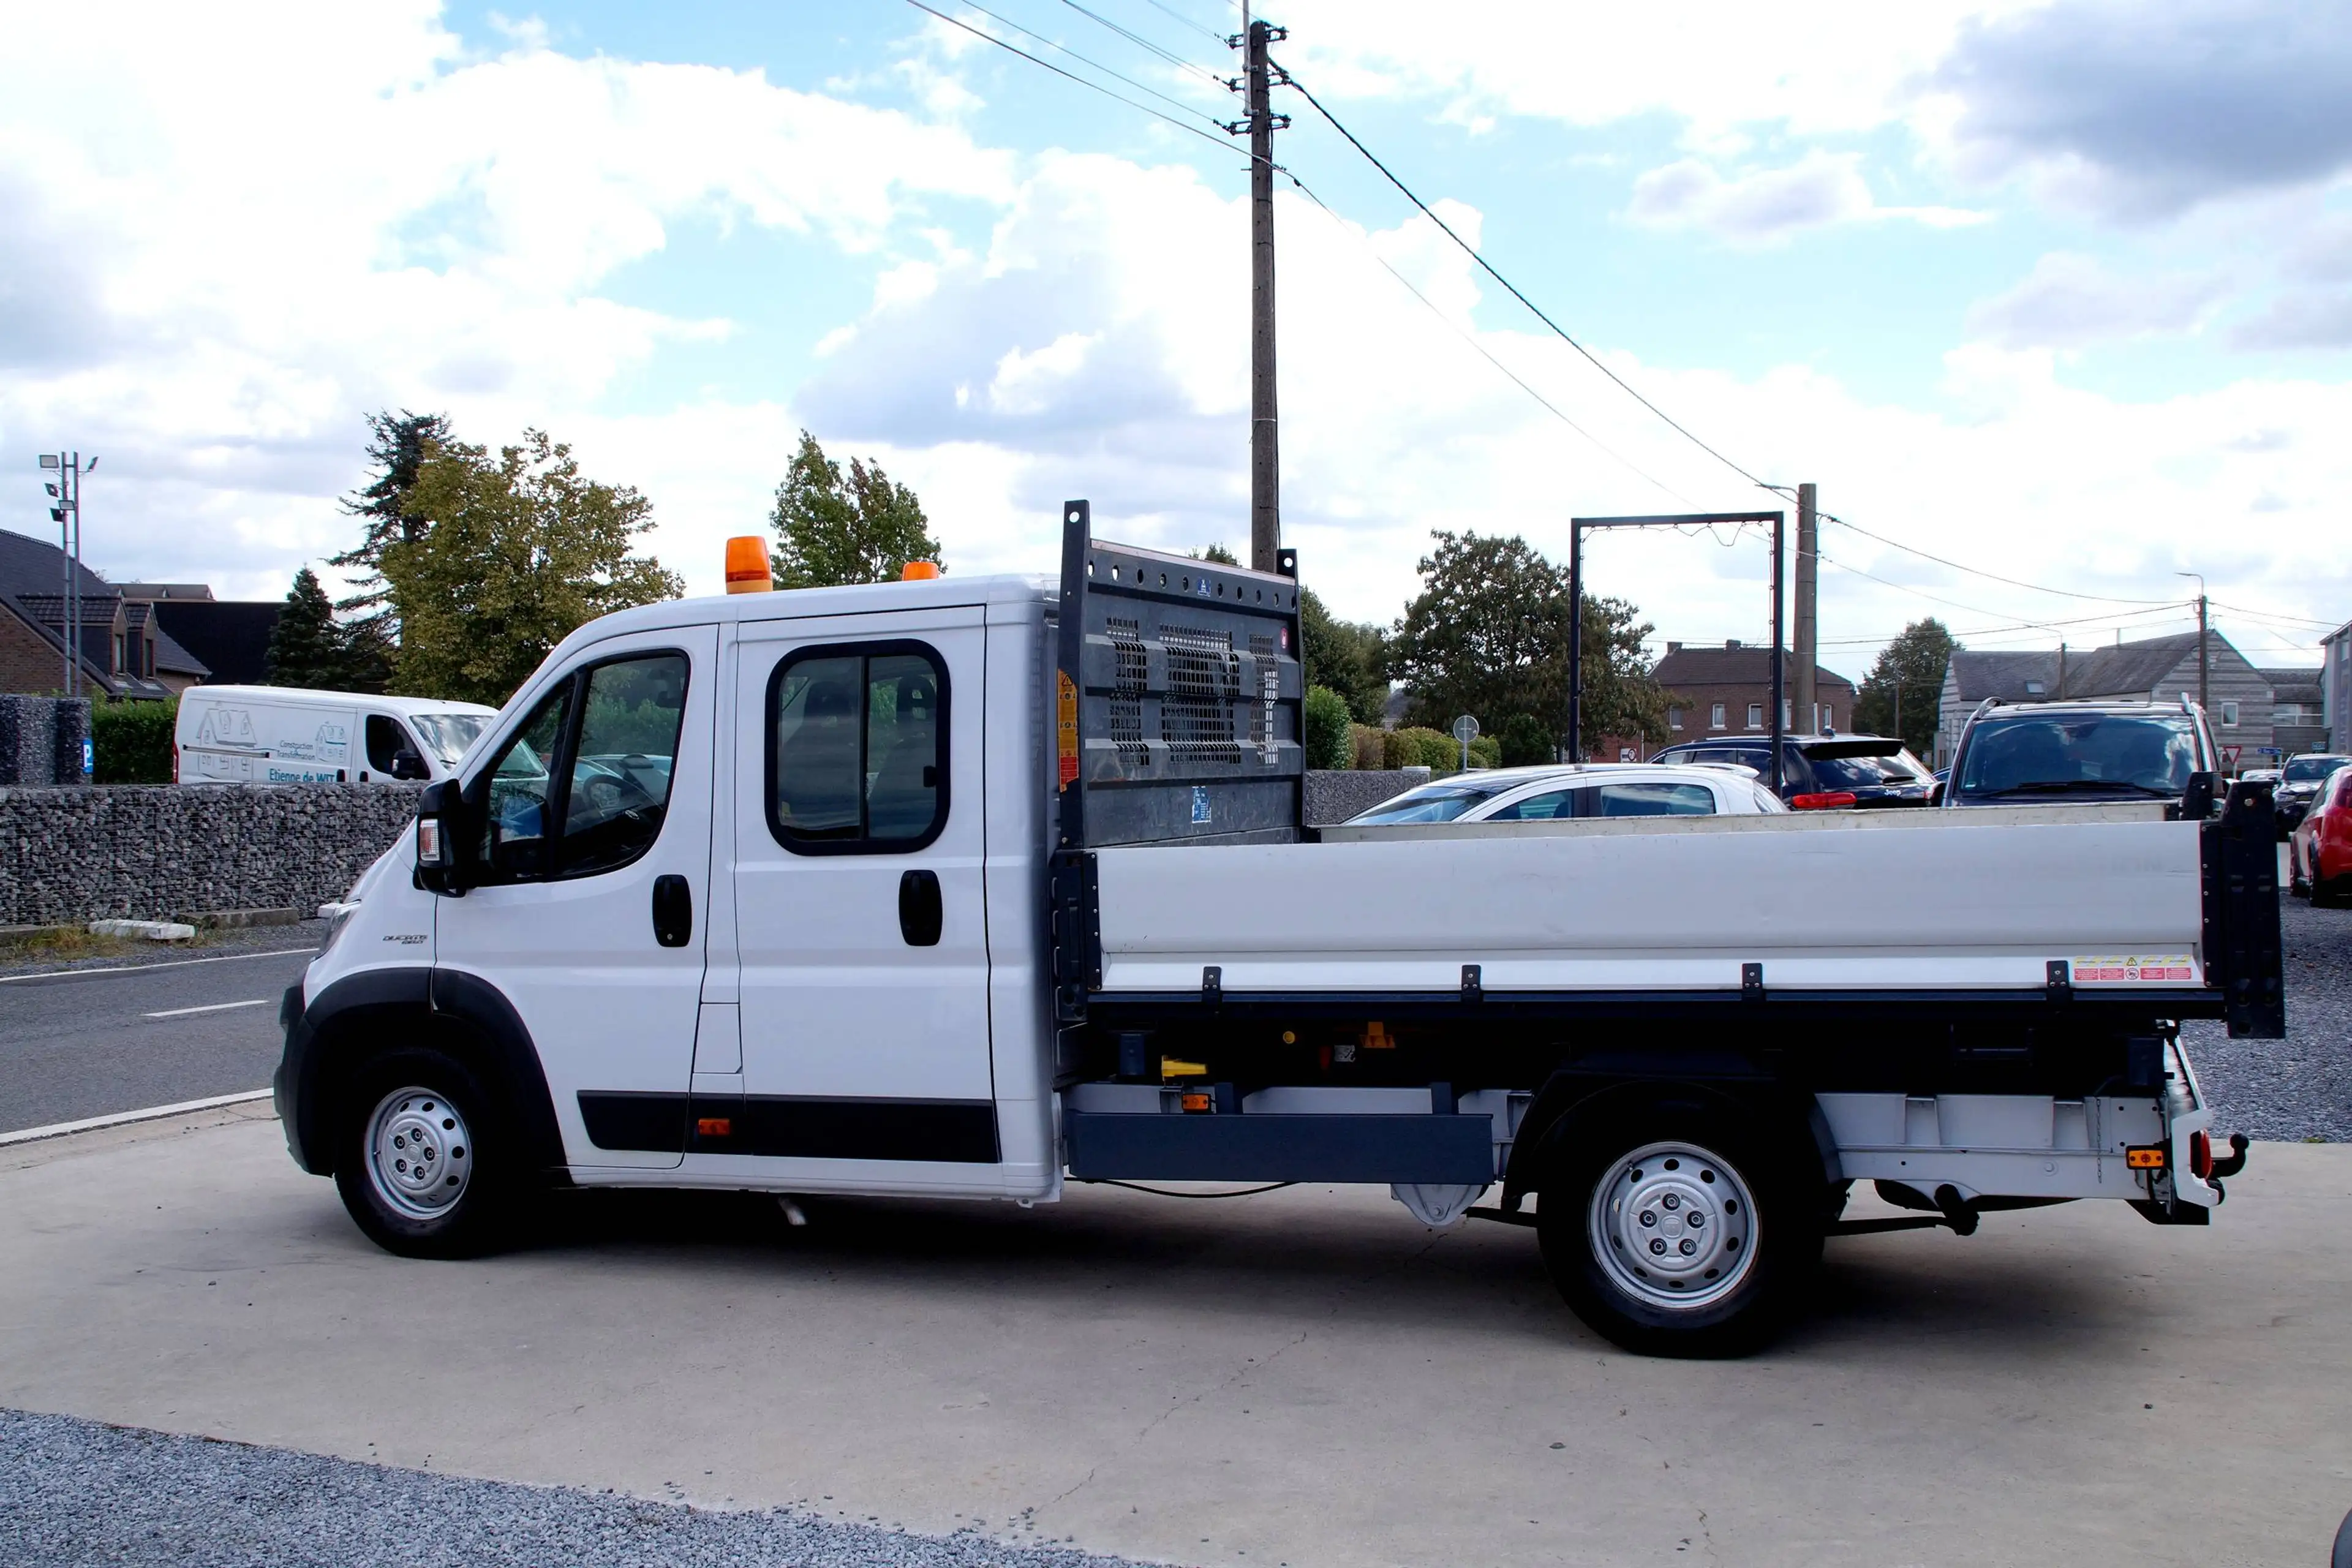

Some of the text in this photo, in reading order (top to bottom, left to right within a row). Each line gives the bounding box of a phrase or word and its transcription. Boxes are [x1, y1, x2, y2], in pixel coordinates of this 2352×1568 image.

[280, 740, 314, 750] Construction
[270, 768, 335, 783] Etienne de WIT
